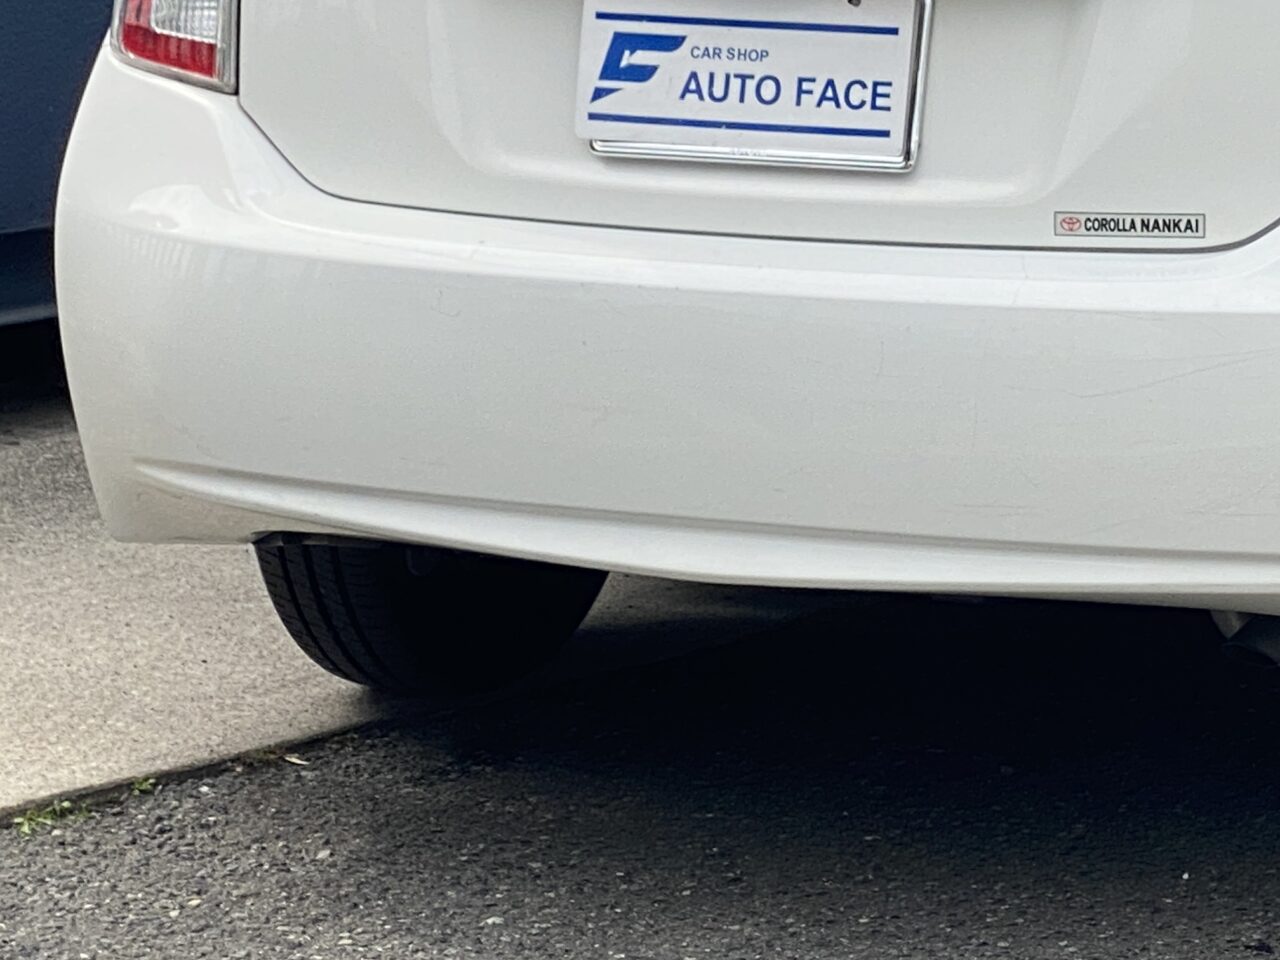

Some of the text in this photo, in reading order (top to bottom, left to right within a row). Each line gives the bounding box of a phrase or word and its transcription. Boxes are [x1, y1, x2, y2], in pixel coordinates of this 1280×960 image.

[690, 46, 769, 62] CAR SHOP
[679, 71, 893, 112] AUTO FACE
[1084, 217, 1200, 233] COROLLA NANKAI
